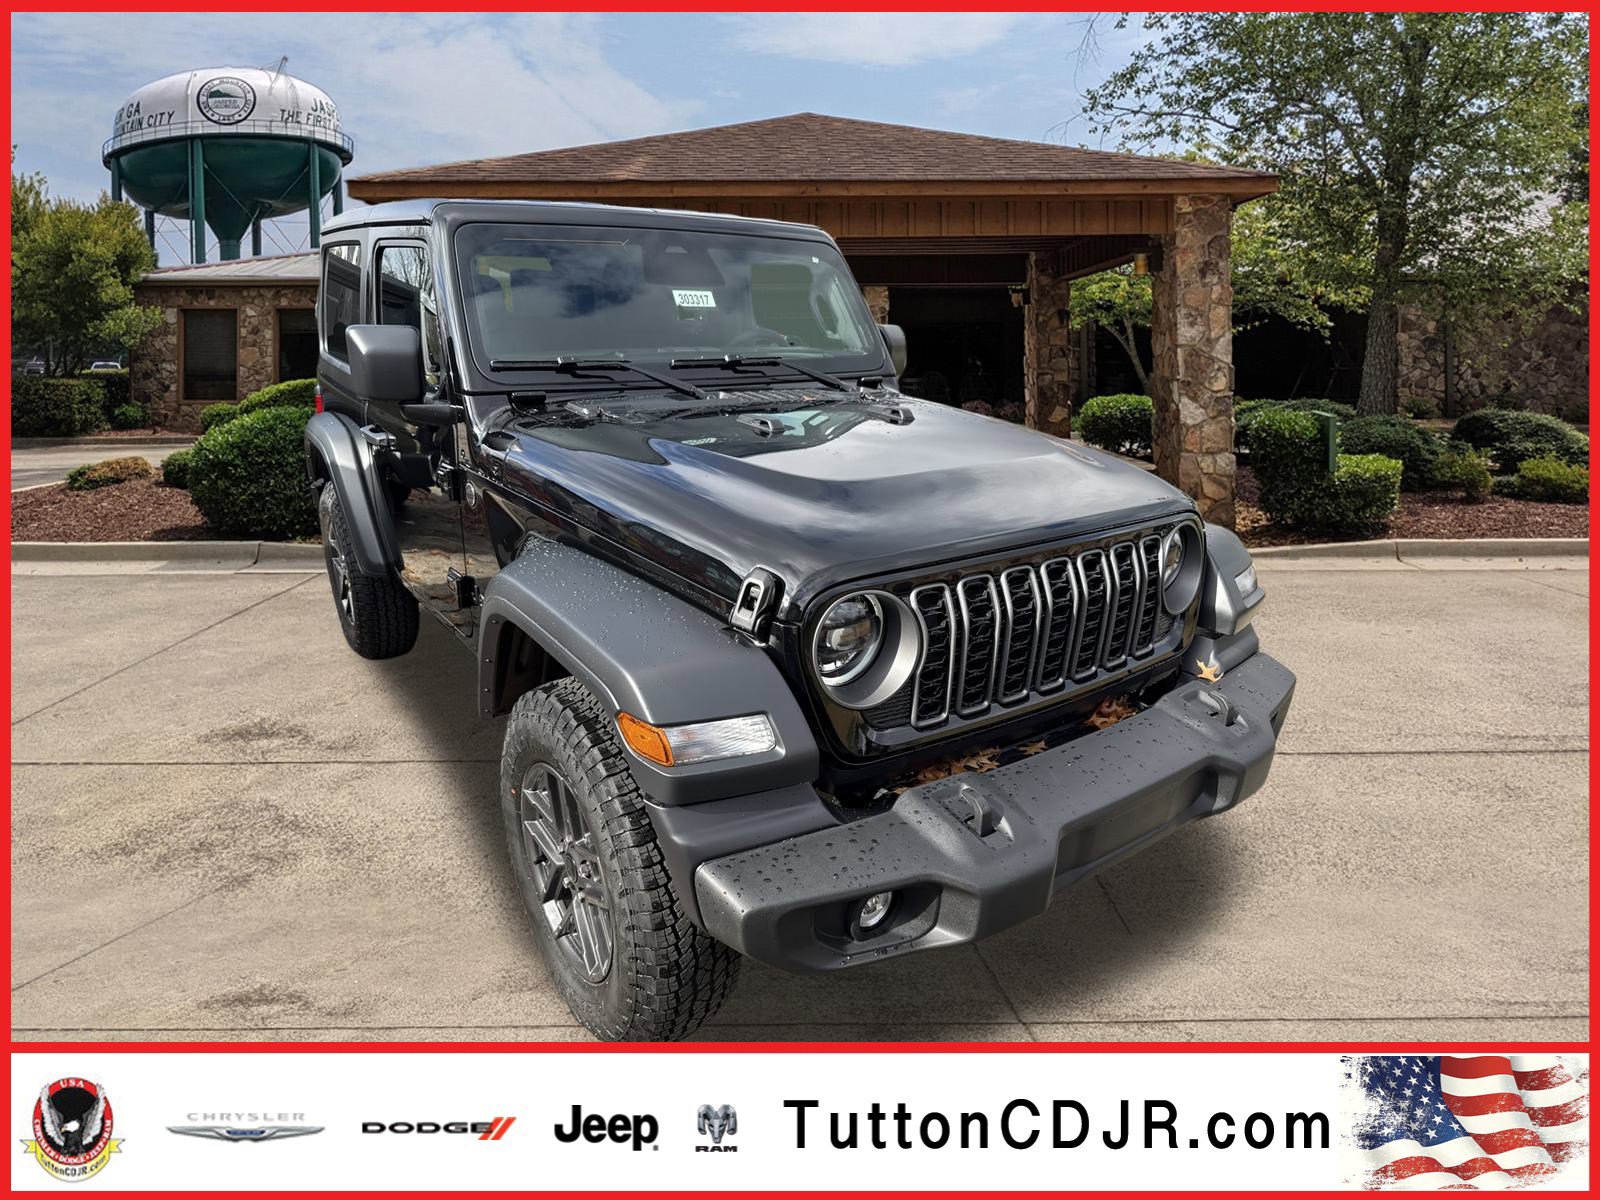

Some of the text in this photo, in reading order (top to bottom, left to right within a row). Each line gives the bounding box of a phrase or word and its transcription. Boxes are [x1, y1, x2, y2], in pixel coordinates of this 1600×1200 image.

[126, 100, 141, 119] GA
[147, 110, 176, 127] CITY
[280, 108, 302, 124] THE
[306, 113, 333, 129] FIRST
[679, 294, 710, 305] 303317
